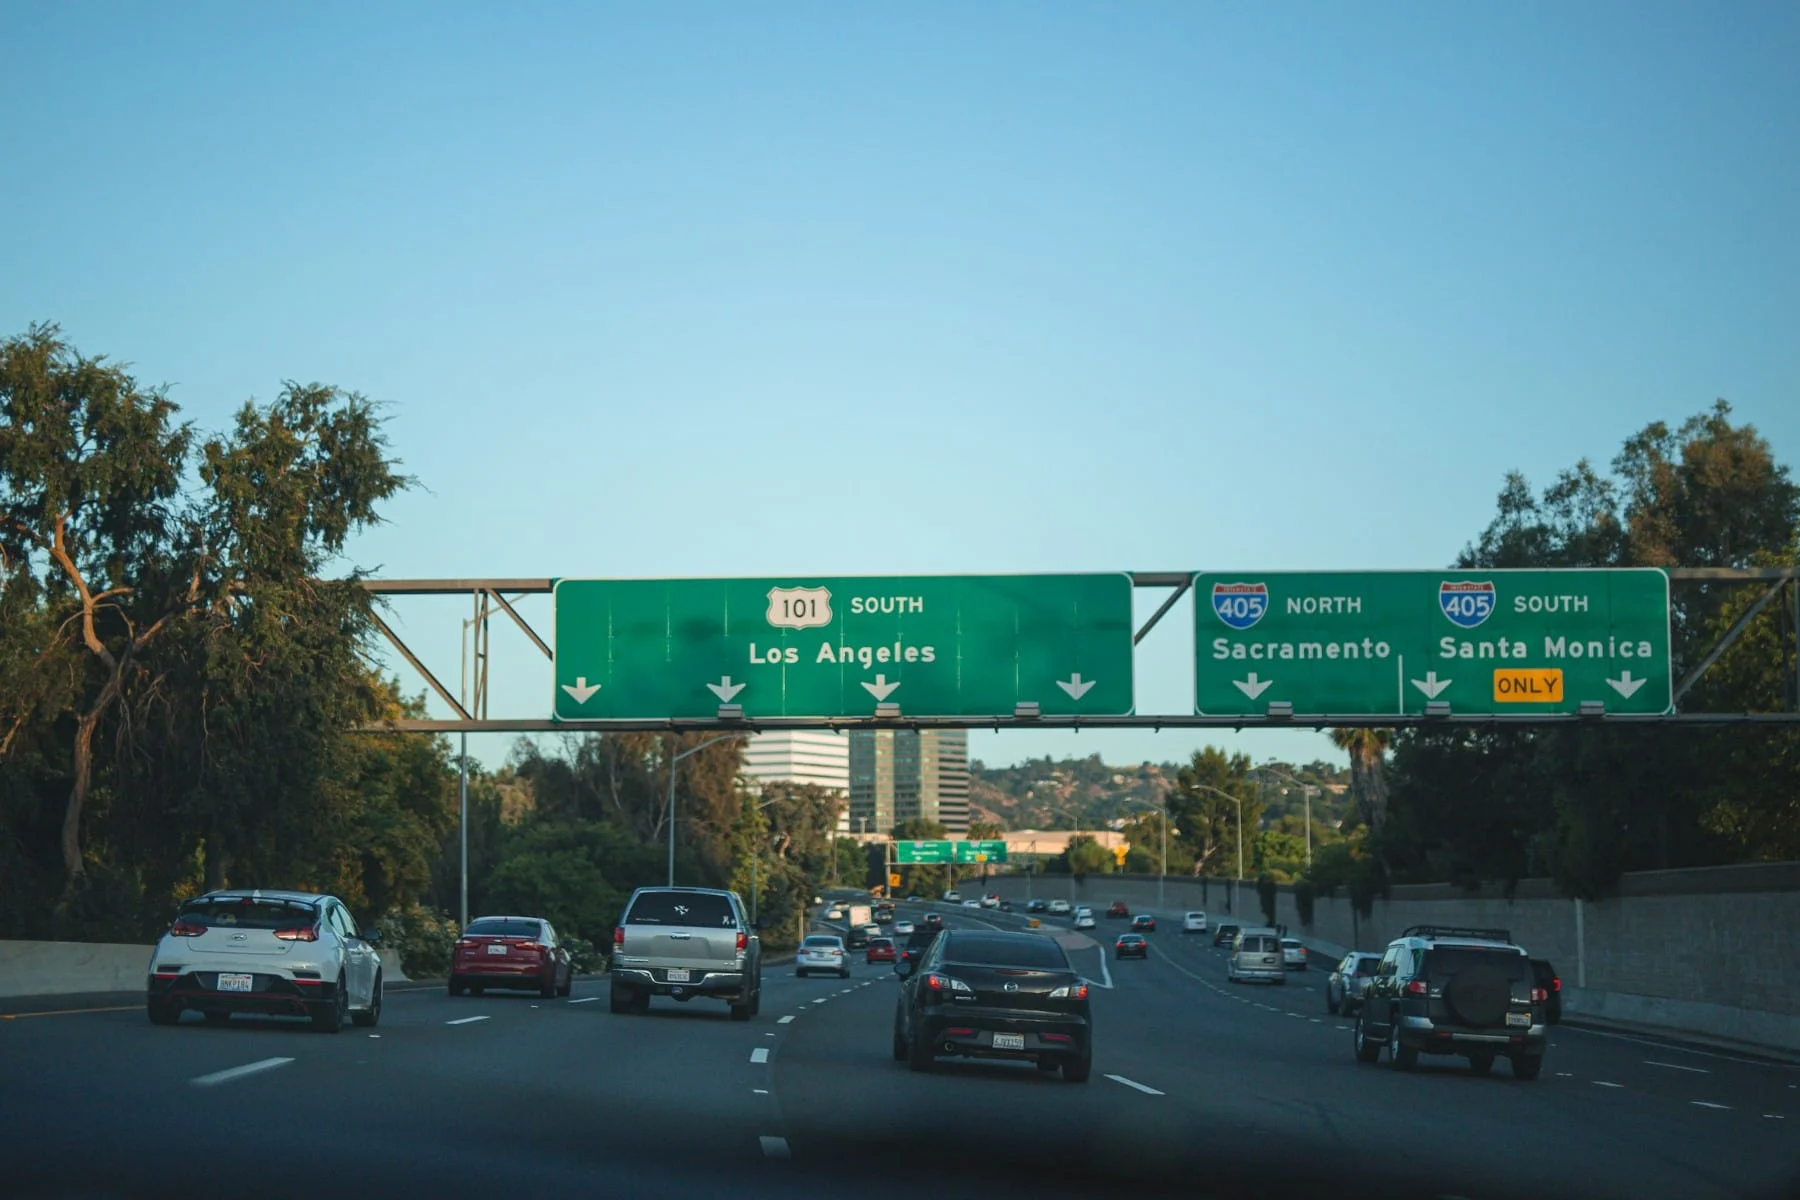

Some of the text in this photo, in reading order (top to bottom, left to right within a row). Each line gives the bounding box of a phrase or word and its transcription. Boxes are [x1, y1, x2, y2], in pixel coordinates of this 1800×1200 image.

[783, 599, 816, 618] 101
[851, 596, 923, 613] SOUTH
[1218, 597, 1263, 618] 405
[1287, 597, 1362, 614] NORTH
[1445, 596, 1490, 617] 405
[1514, 595, 1588, 612] SOUTH
[750, 641, 936, 670] Los Angeles
[1212, 637, 1391, 660] Sacramento
[1439, 636, 1653, 659] Santa Monica
[1497, 677, 1558, 694] ONLY
